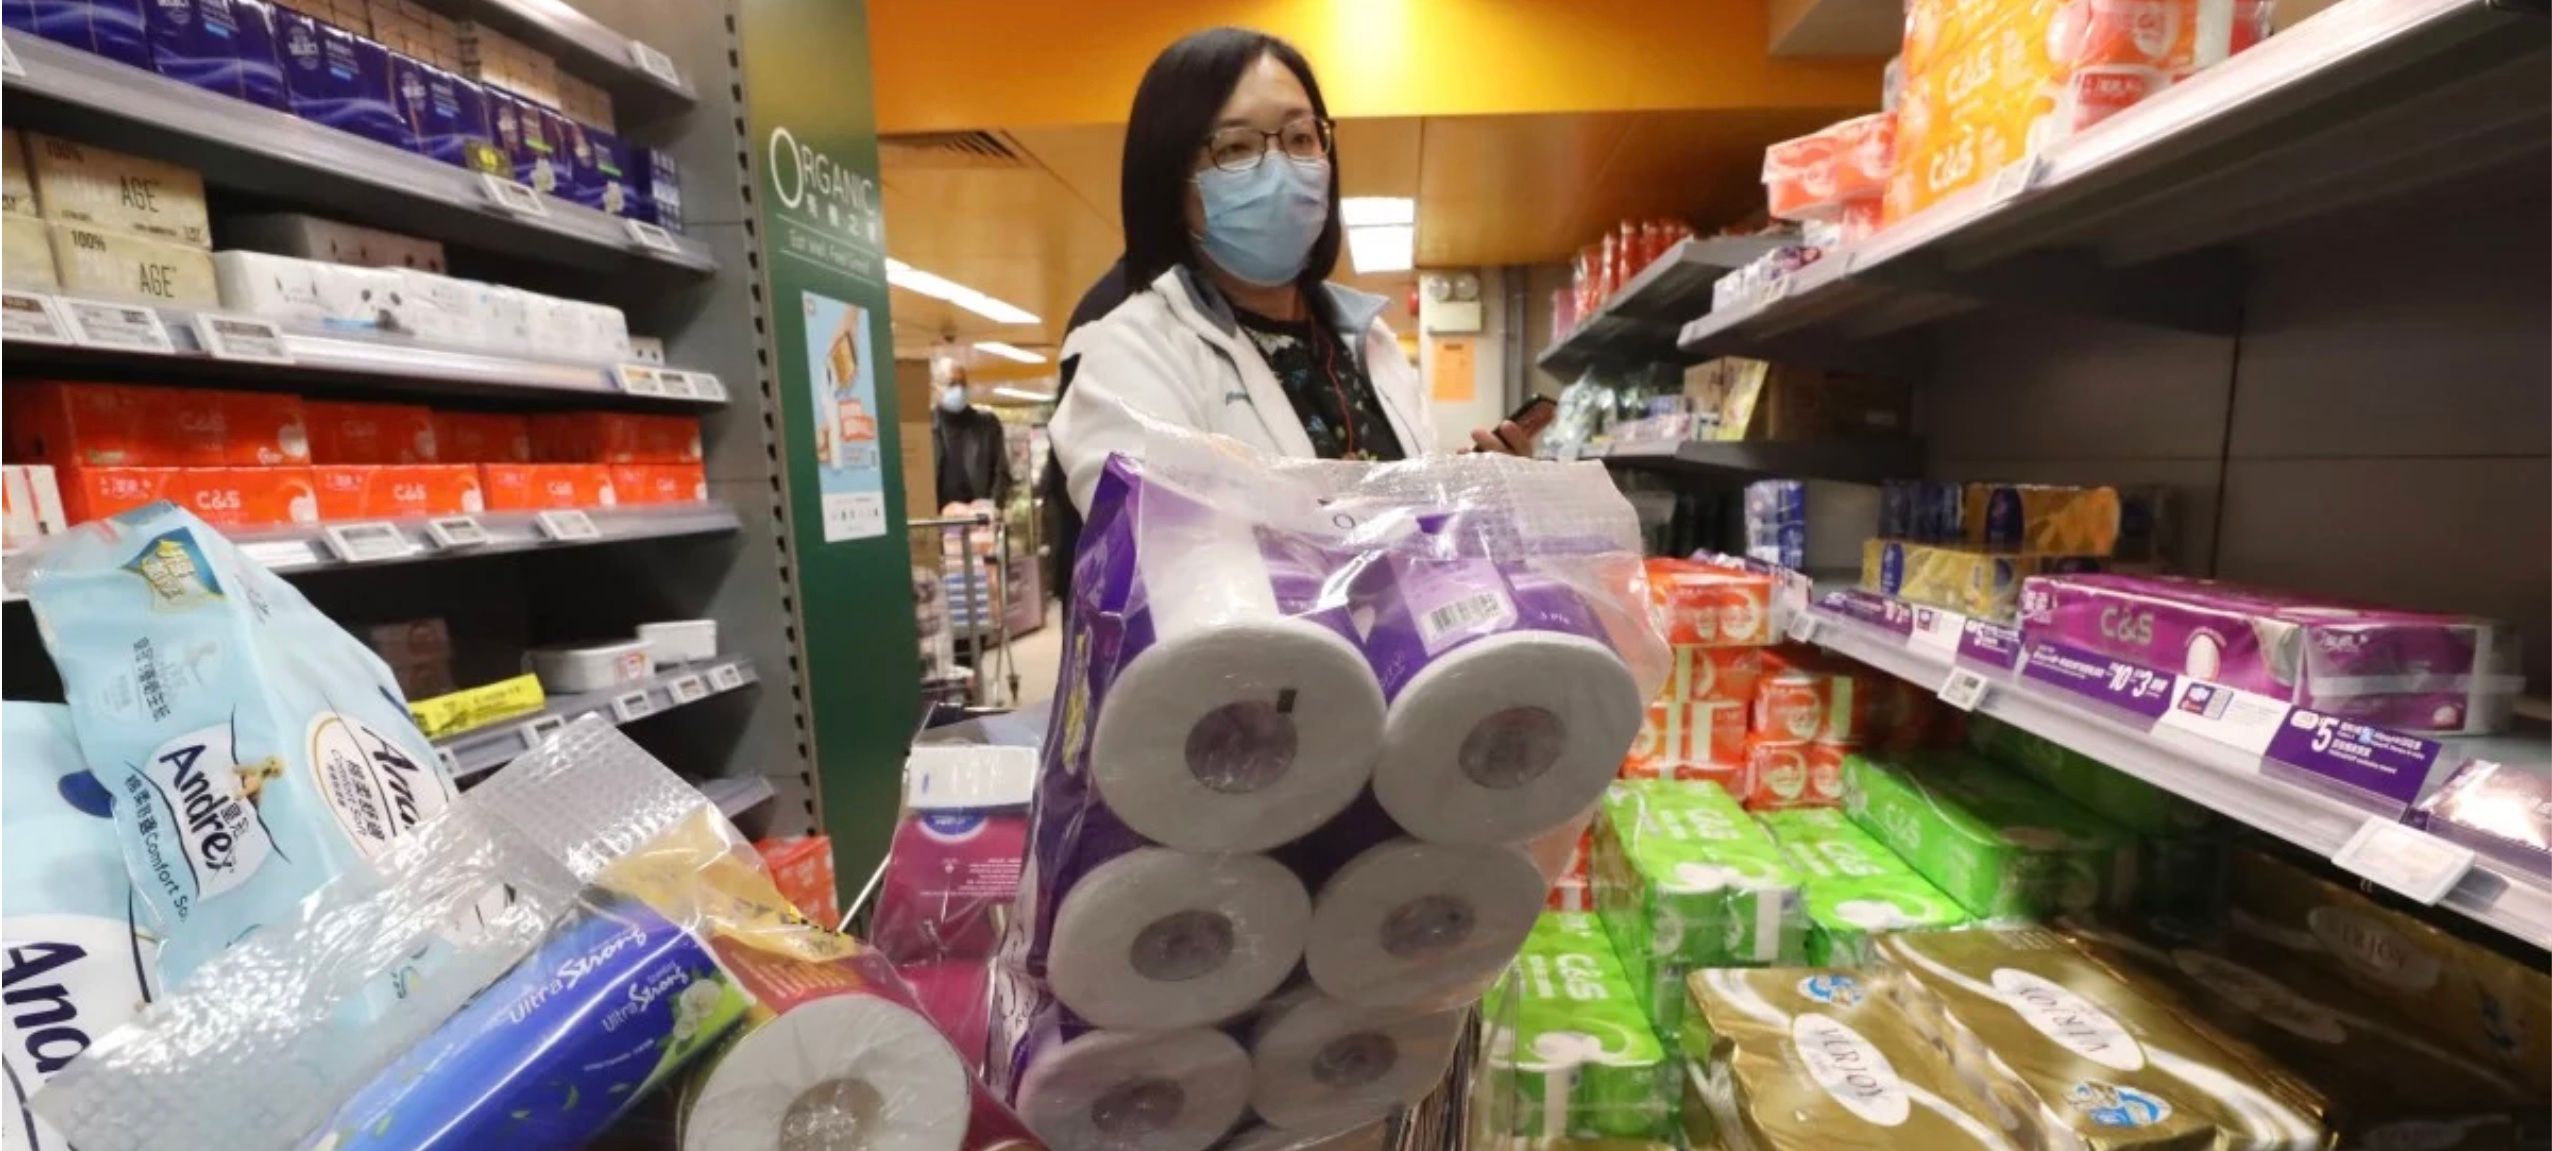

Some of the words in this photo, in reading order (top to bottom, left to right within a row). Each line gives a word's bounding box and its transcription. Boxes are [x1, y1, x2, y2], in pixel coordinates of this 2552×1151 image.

[769, 127, 876, 216] ORGANIC
[71, 229, 107, 252] 100%
[196, 490, 241, 510] C&S
[2101, 605, 2155, 646] C&S
[158, 744, 234, 872] Andrex
[145, 830, 181, 895] Comfort
[509, 979, 564, 1024] Ultra
[555, 927, 647, 991] Strong
[602, 1002, 638, 1033] Ultra
[627, 965, 689, 1012] Strong
